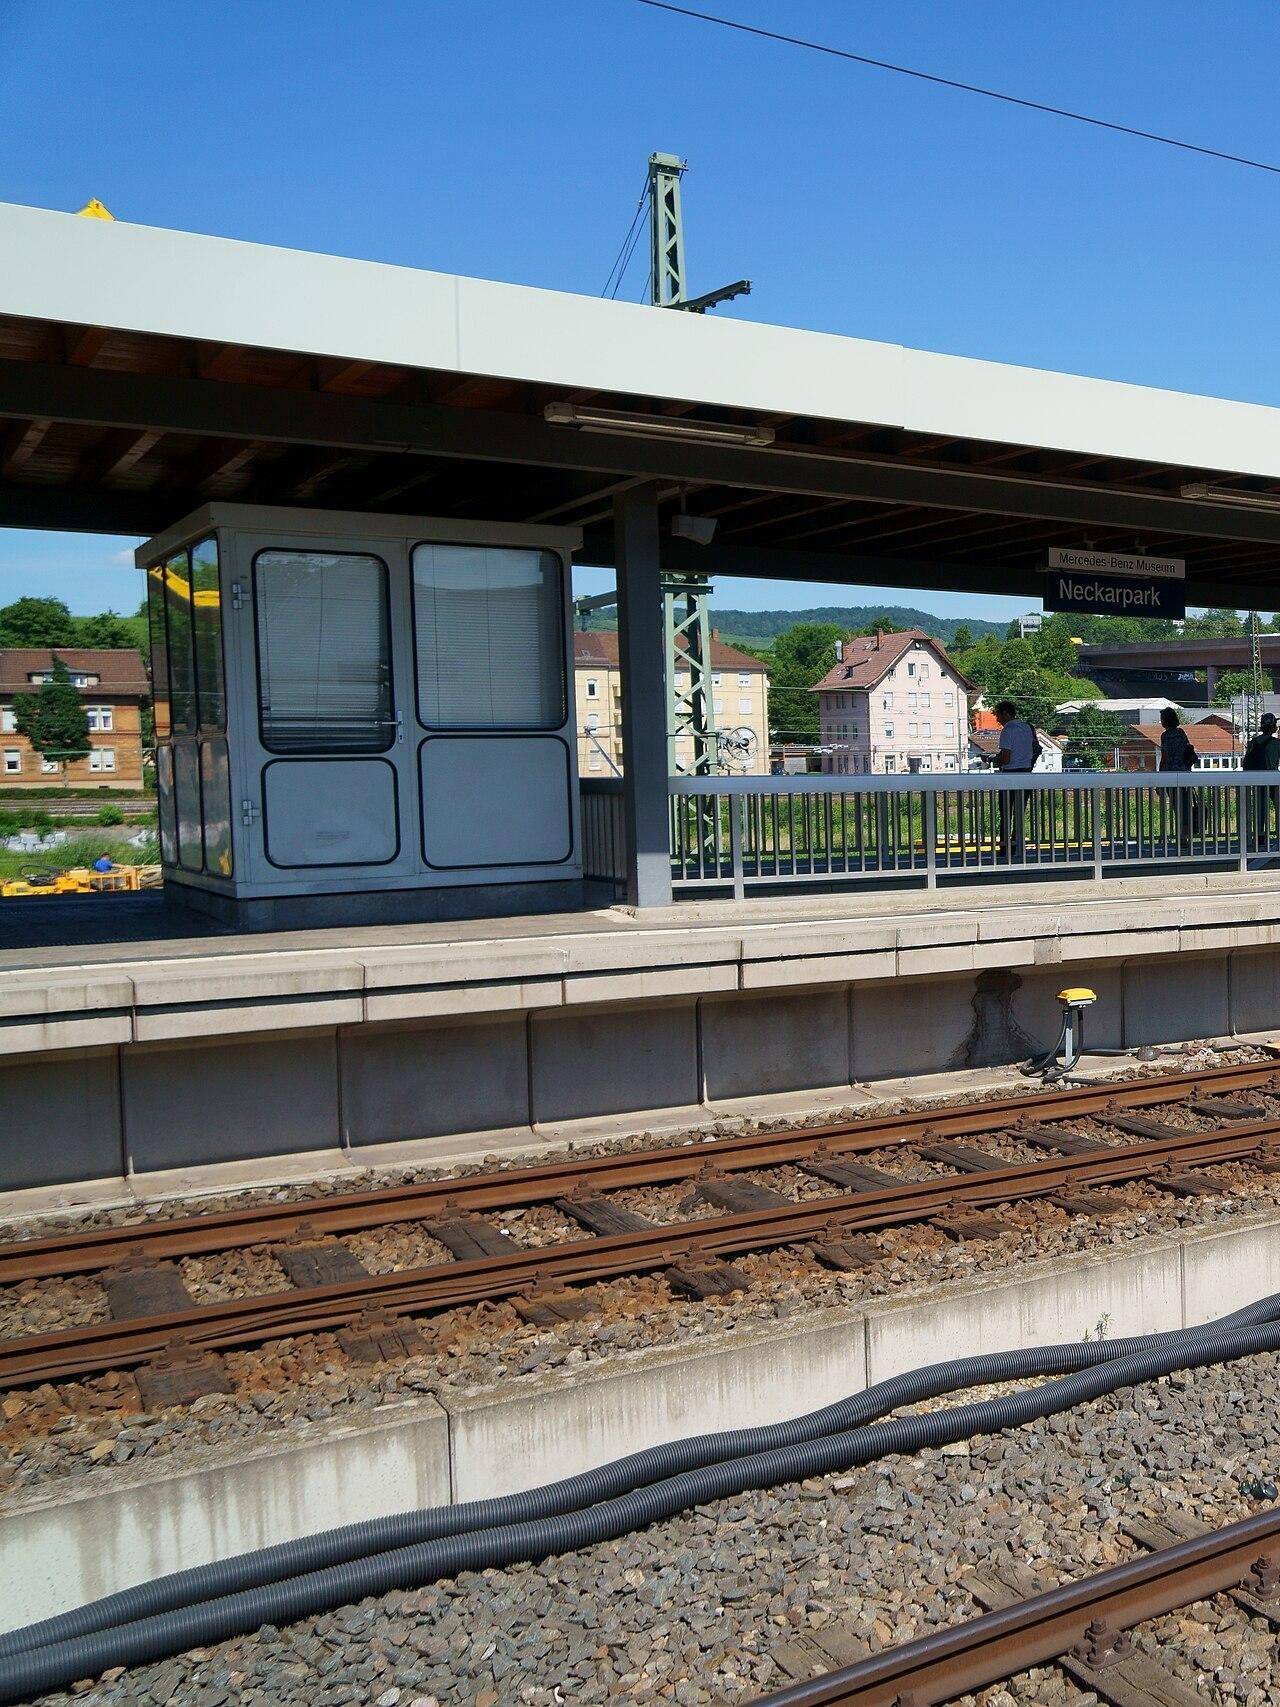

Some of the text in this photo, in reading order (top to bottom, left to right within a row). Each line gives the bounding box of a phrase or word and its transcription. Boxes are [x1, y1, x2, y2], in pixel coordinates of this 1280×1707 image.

[1059, 552, 1176, 573] Mercedes-Benz Museum
[1059, 579, 1161, 609] Neckarpark
